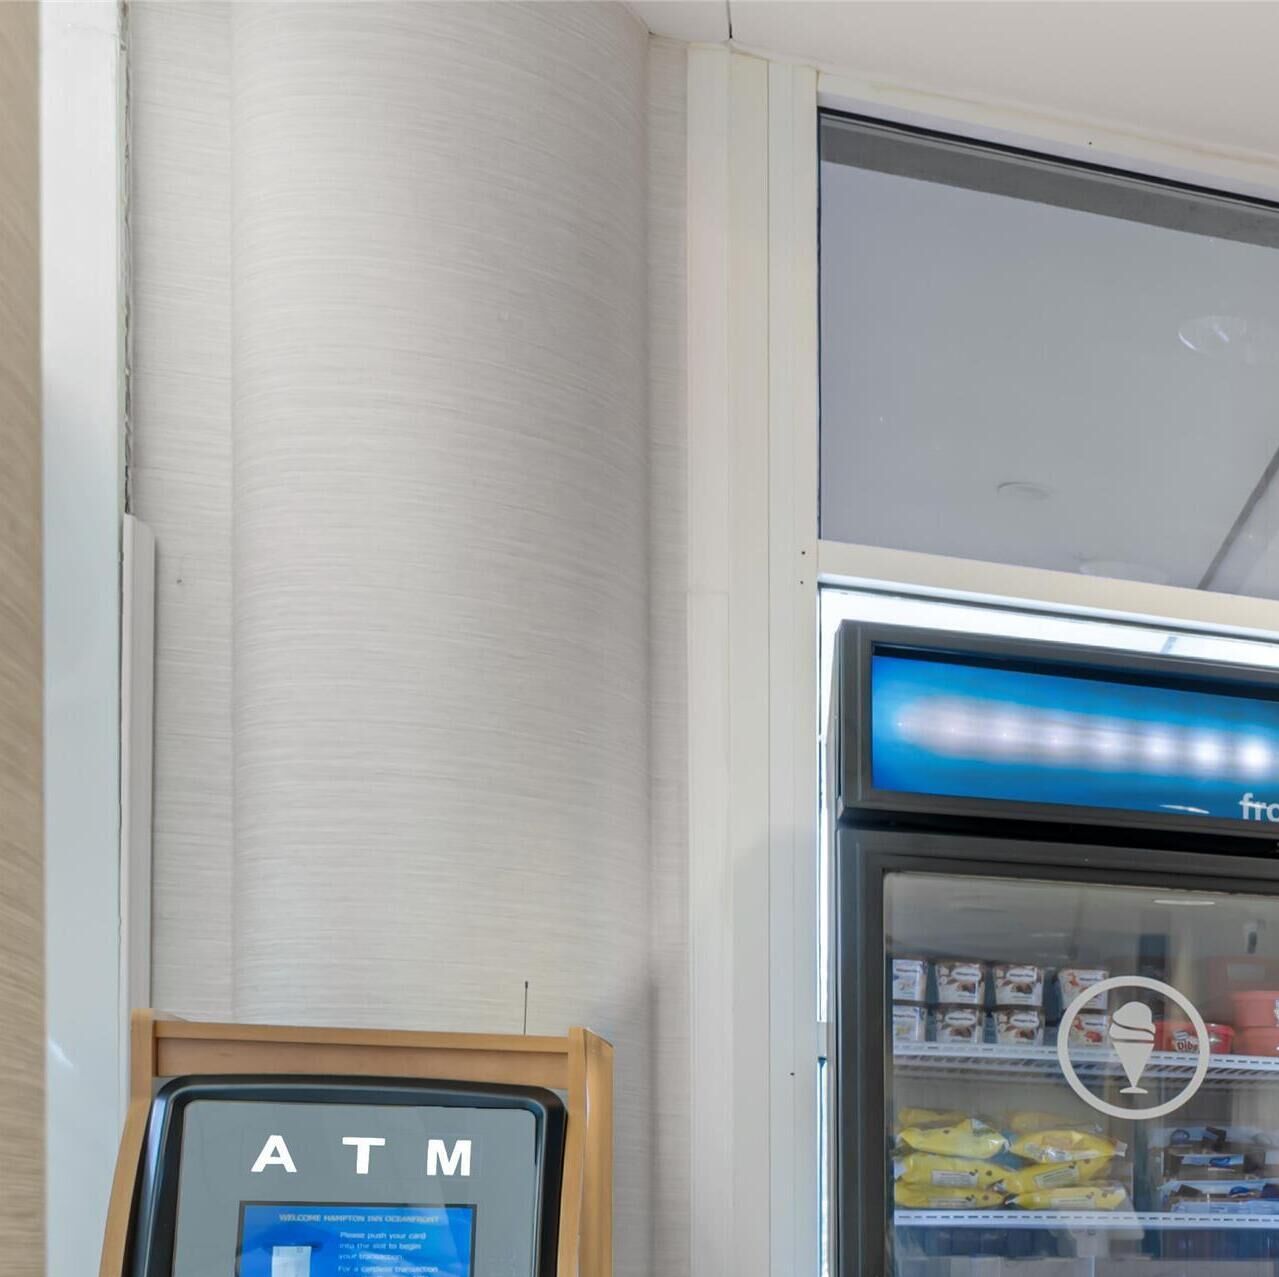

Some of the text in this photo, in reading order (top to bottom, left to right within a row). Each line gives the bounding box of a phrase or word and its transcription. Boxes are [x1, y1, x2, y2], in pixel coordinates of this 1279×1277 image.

[250, 1134, 472, 1177] ATM
[279, 1214, 321, 1222] WELCOME
[385, 1215, 441, 1223] OCEANFRONT
[367, 1232, 387, 1240] push
